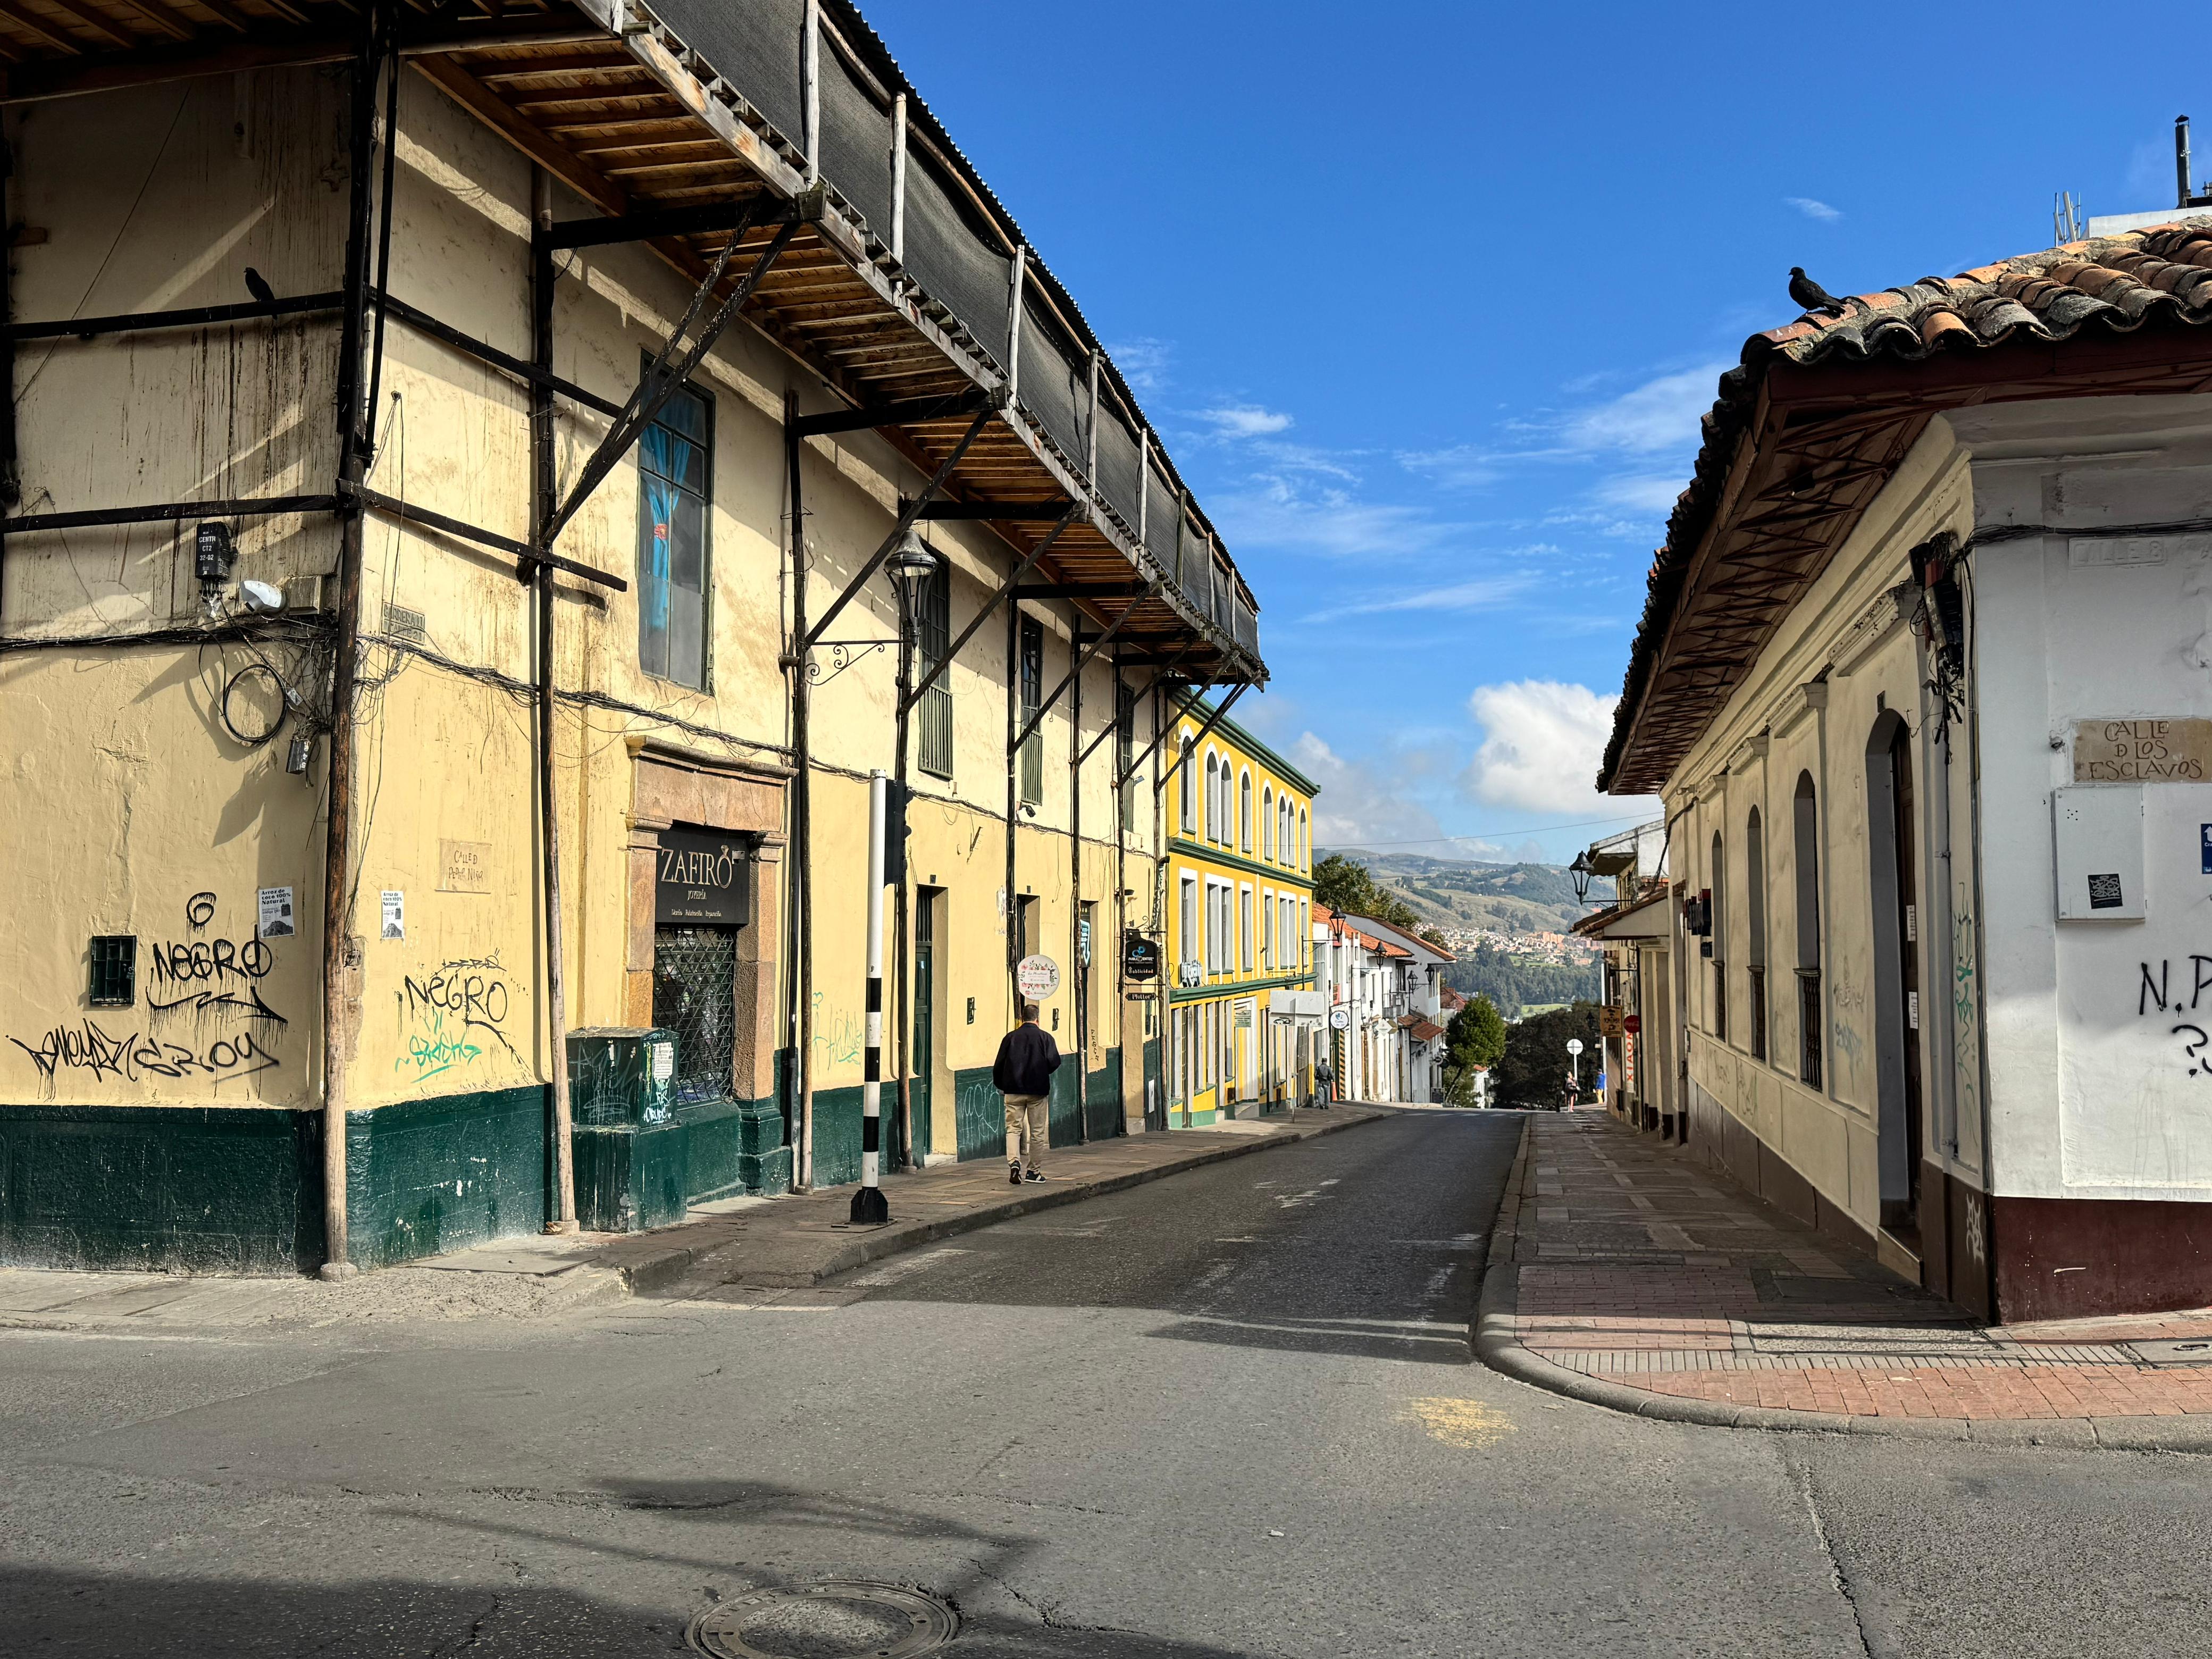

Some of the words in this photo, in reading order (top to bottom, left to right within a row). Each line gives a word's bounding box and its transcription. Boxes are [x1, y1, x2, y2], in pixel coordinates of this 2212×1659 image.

[2104, 720, 2169, 742] CALLE
[2134, 740, 2168, 759] LOS
[2089, 758, 2202, 781] ESCLAVOS
[661, 845, 732, 889] ZAFIRO
